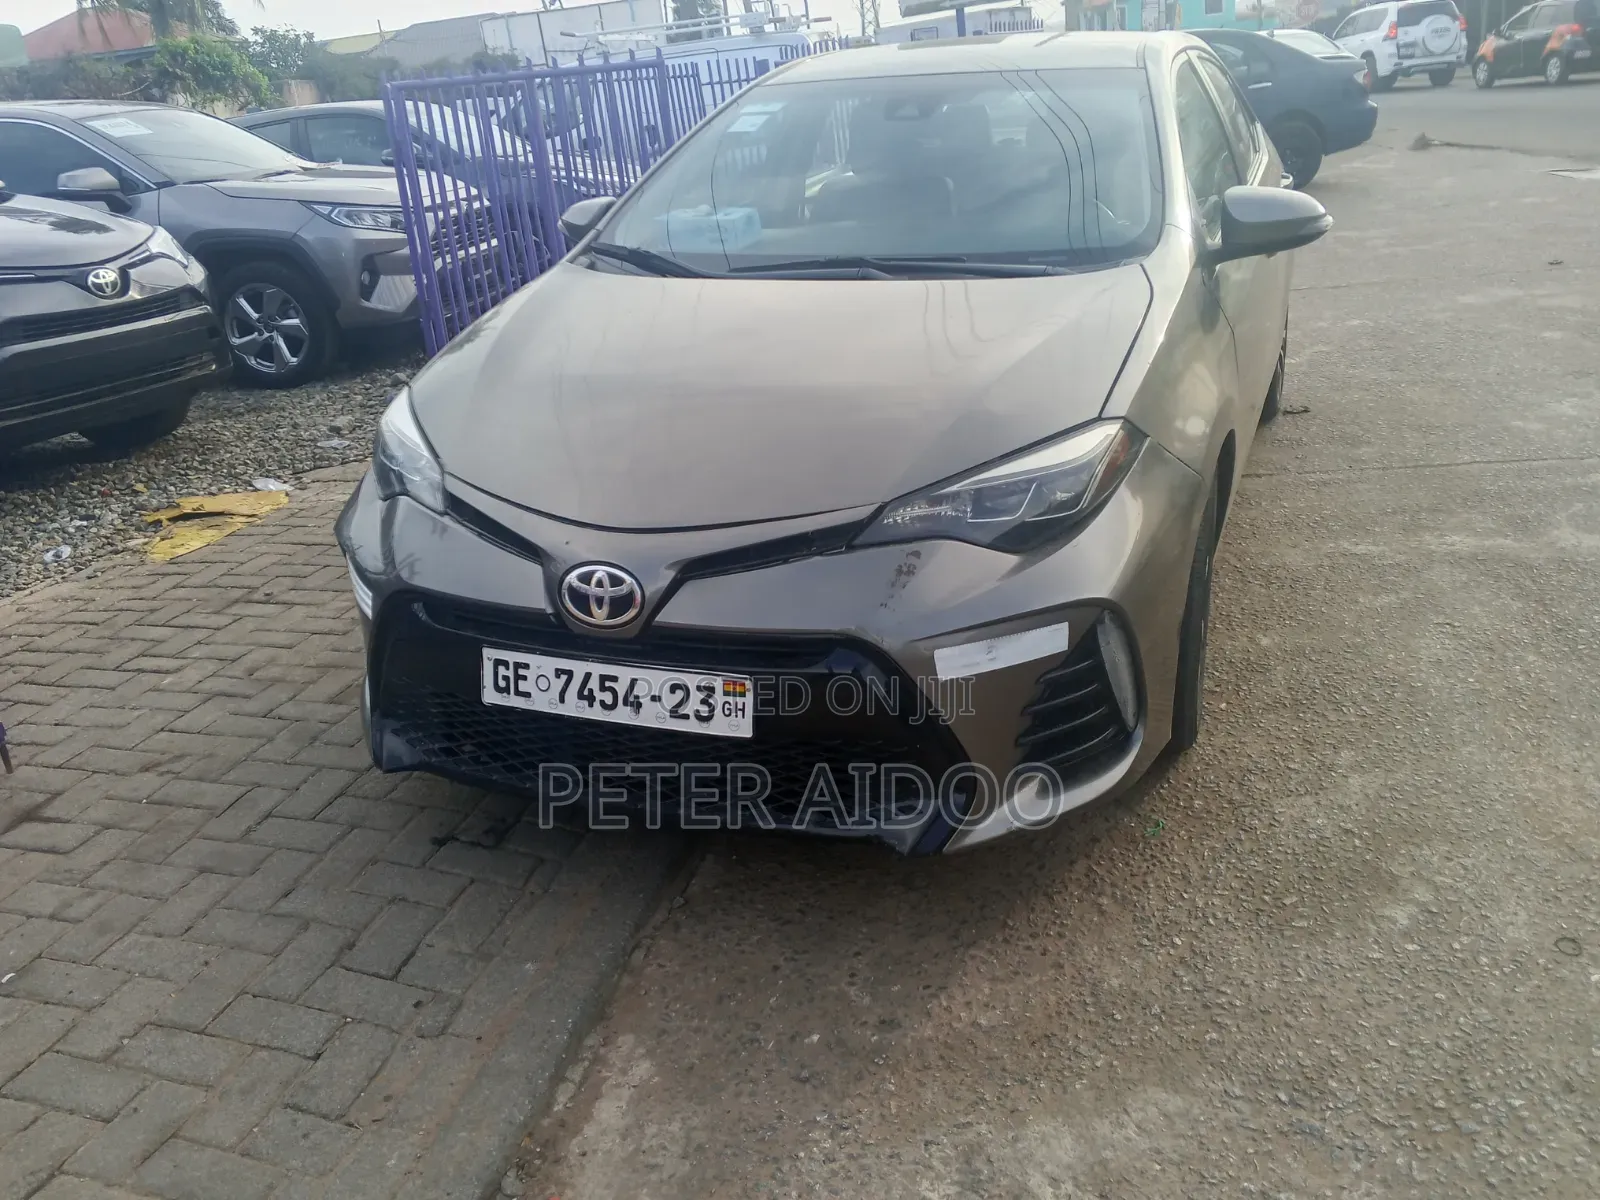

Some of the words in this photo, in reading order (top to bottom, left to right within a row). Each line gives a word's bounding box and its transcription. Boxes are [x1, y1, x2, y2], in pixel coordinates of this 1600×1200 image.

[492, 658, 532, 698] GE
[554, 668, 716, 722] 7454-23
[721, 700, 746, 720] GH
